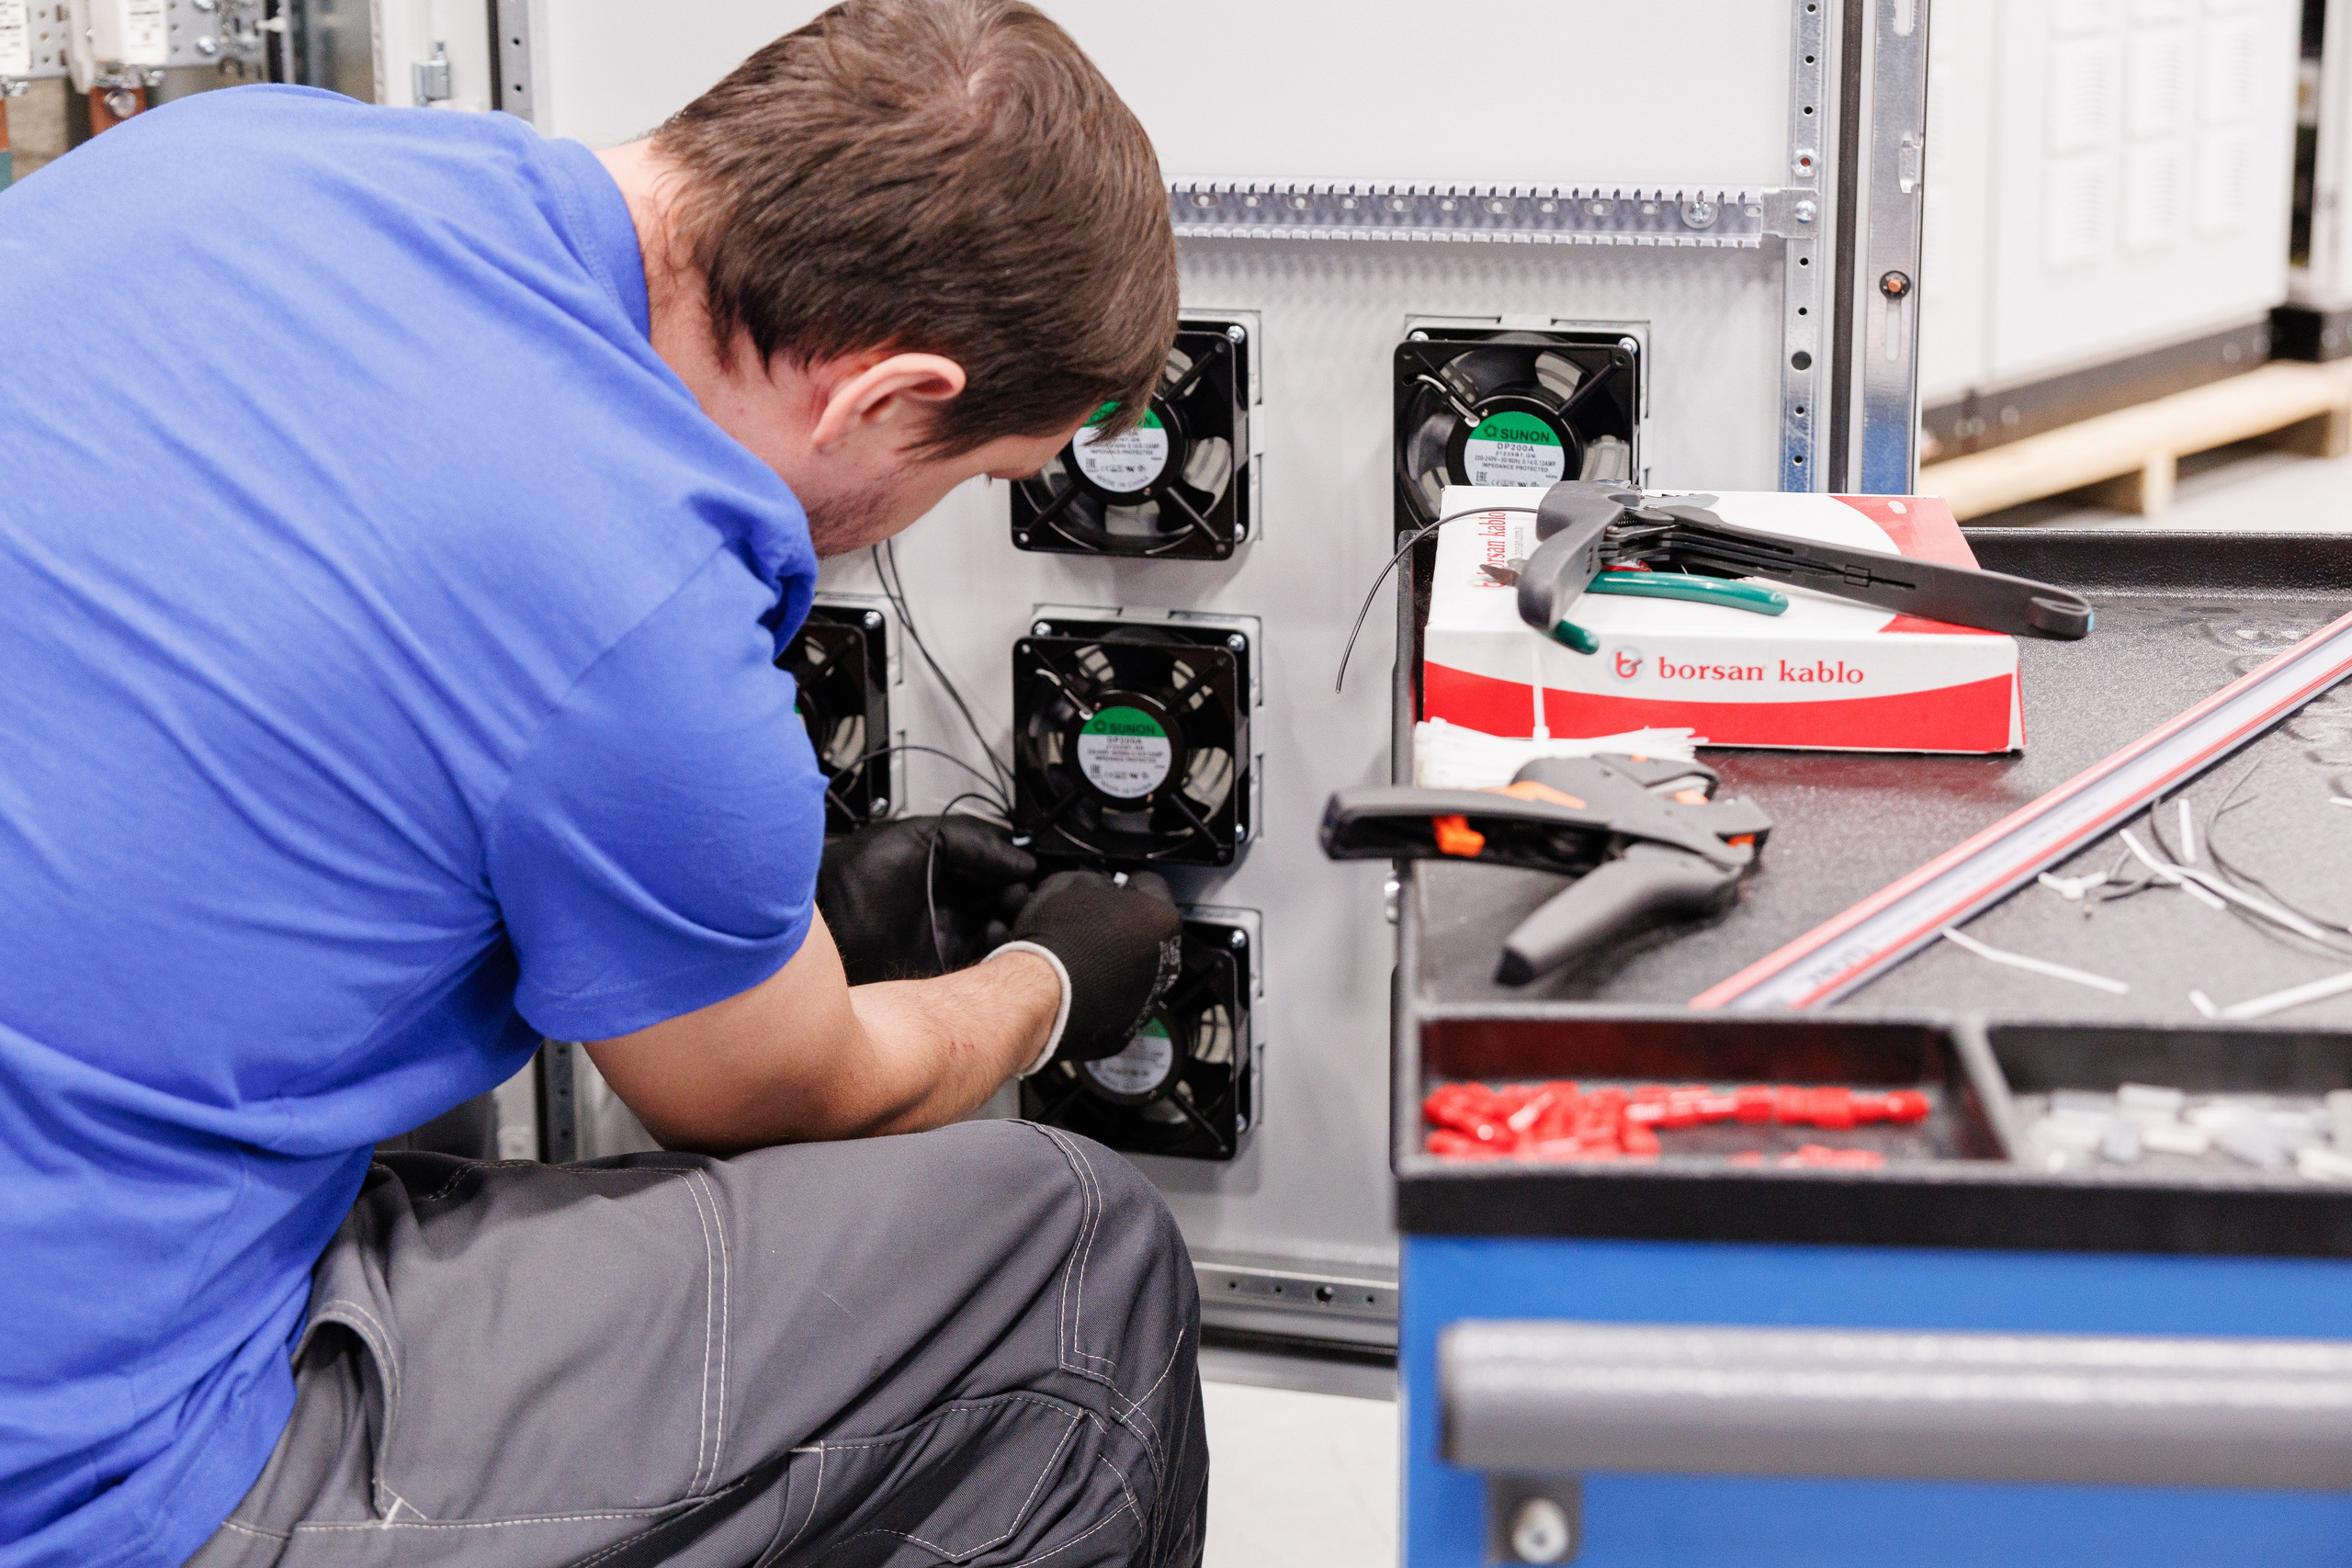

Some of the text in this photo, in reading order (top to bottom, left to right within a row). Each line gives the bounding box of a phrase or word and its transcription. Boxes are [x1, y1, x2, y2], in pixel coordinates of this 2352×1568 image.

[1500, 428, 1550, 443] SUNON
[1497, 443, 1534, 452] DP200A
[1478, 512, 1506, 537] kablo
[1658, 656, 1764, 682] borsan
[1779, 659, 1865, 683] kablo
[1109, 723, 1156, 735] SUNON
